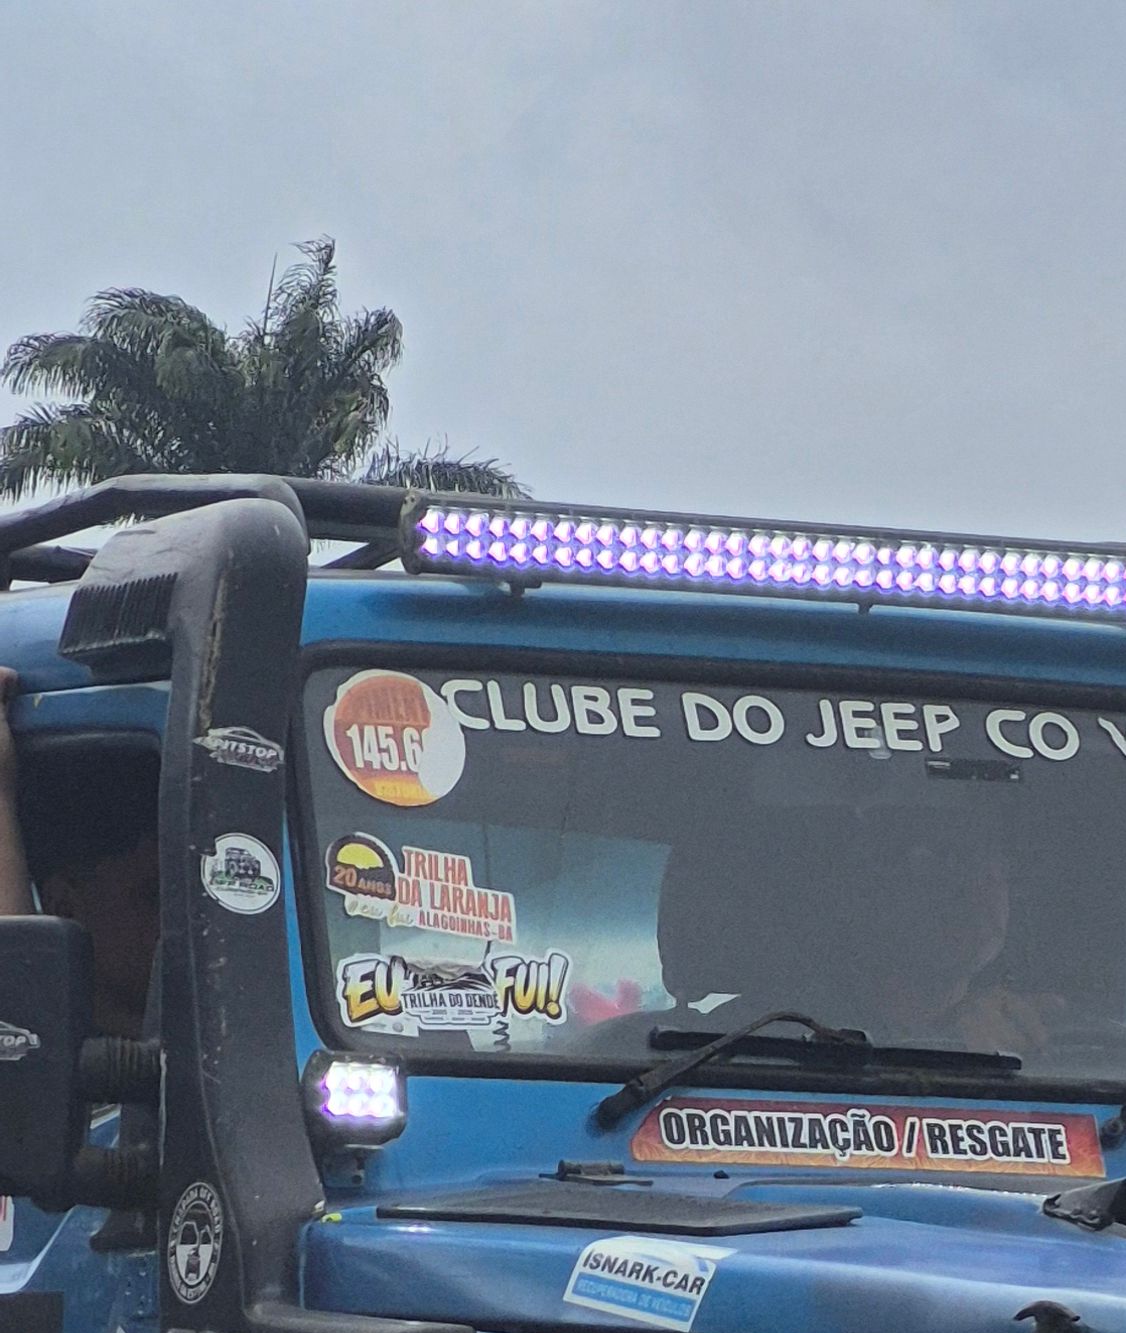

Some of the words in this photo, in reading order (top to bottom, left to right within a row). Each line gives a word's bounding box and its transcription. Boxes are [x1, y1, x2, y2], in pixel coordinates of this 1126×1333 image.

[440, 678, 661, 738] CLUBE
[682, 691, 785, 745] DO
[806, 698, 960, 753] JEEP
[345, 723, 429, 773] 145.6
[332, 865, 358, 888] 20
[403, 849, 469, 886] TRILHA
[398, 877, 423, 907] DA
[430, 881, 512, 923] LARANJA
[343, 956, 408, 1022] EU
[491, 953, 568, 1020] FUI!
[401, 992, 447, 1009] TRILHA
[661, 1111, 895, 1159] ORGANIZAÇÃO
[926, 1122, 1068, 1161] RESGATE
[582, 1250, 706, 1296] ISNARK-CAR
